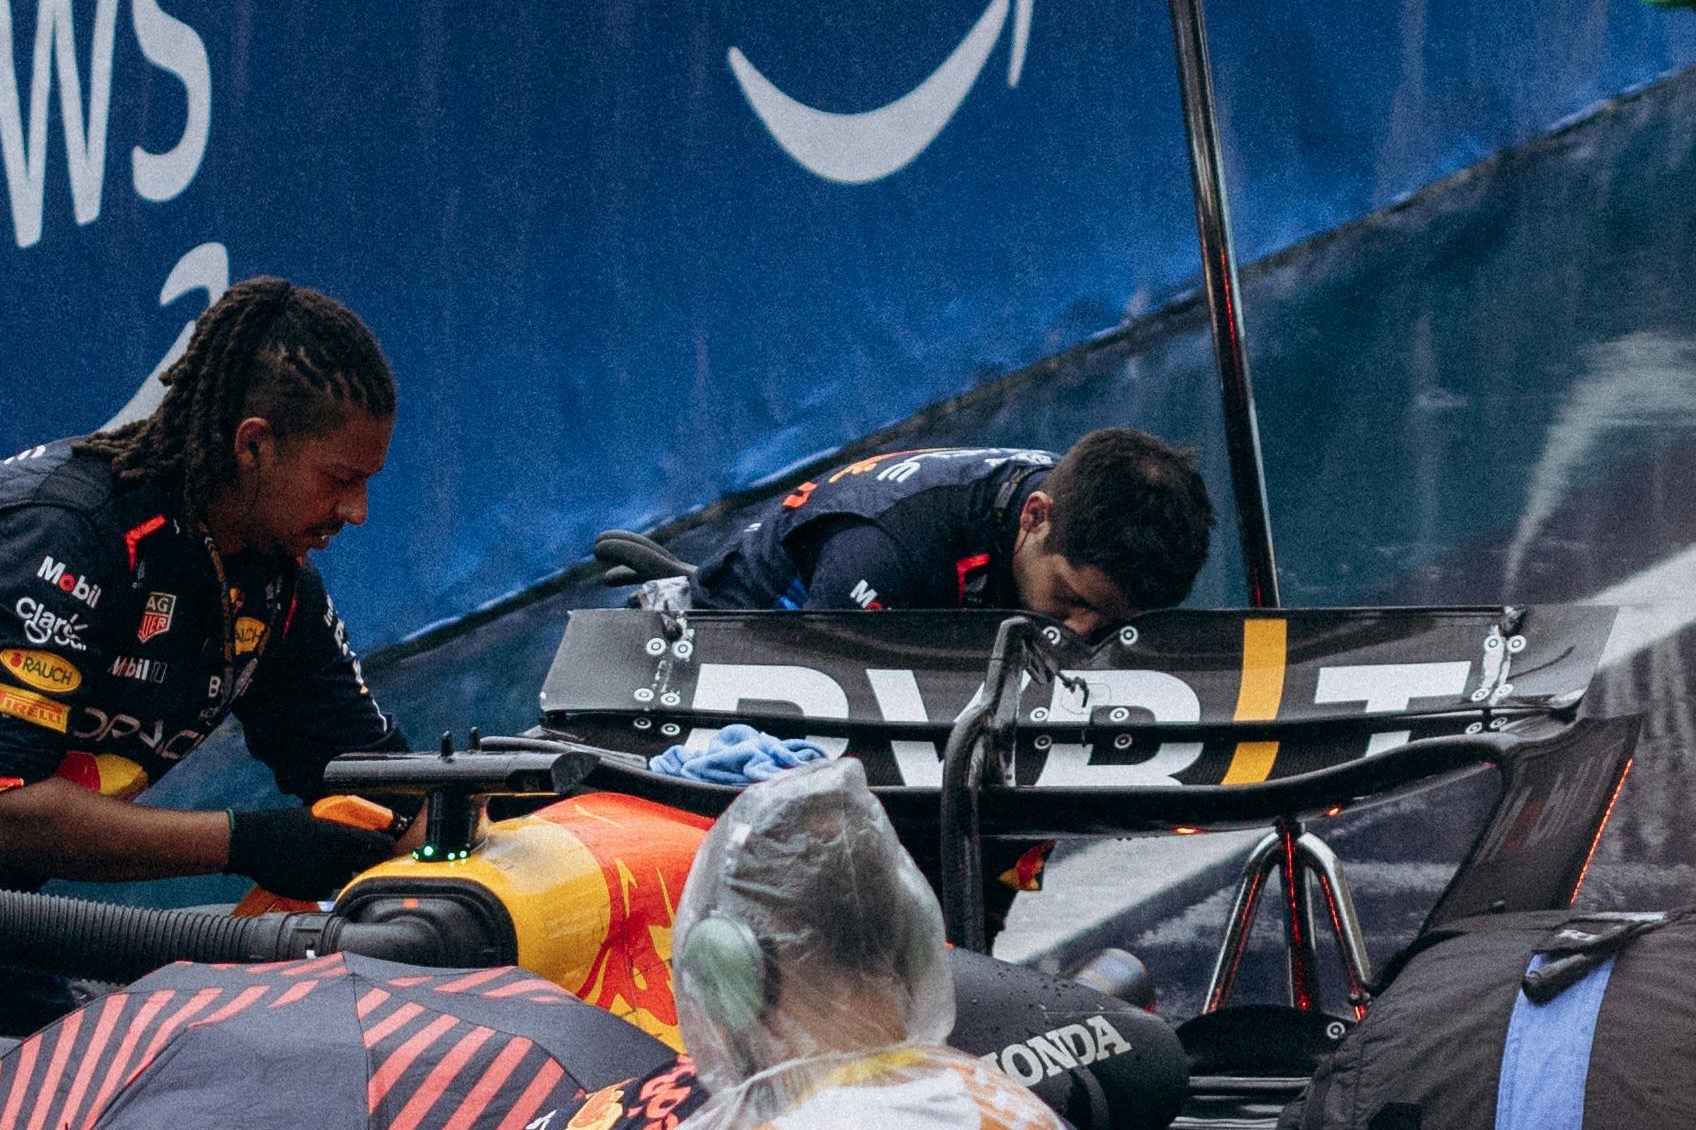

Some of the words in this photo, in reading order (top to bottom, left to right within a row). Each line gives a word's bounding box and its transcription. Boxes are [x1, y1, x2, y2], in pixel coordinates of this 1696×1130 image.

[36, 555, 102, 609] Mobil
[145, 595, 170, 613] AG
[22, 656, 73, 686] RAUCH
